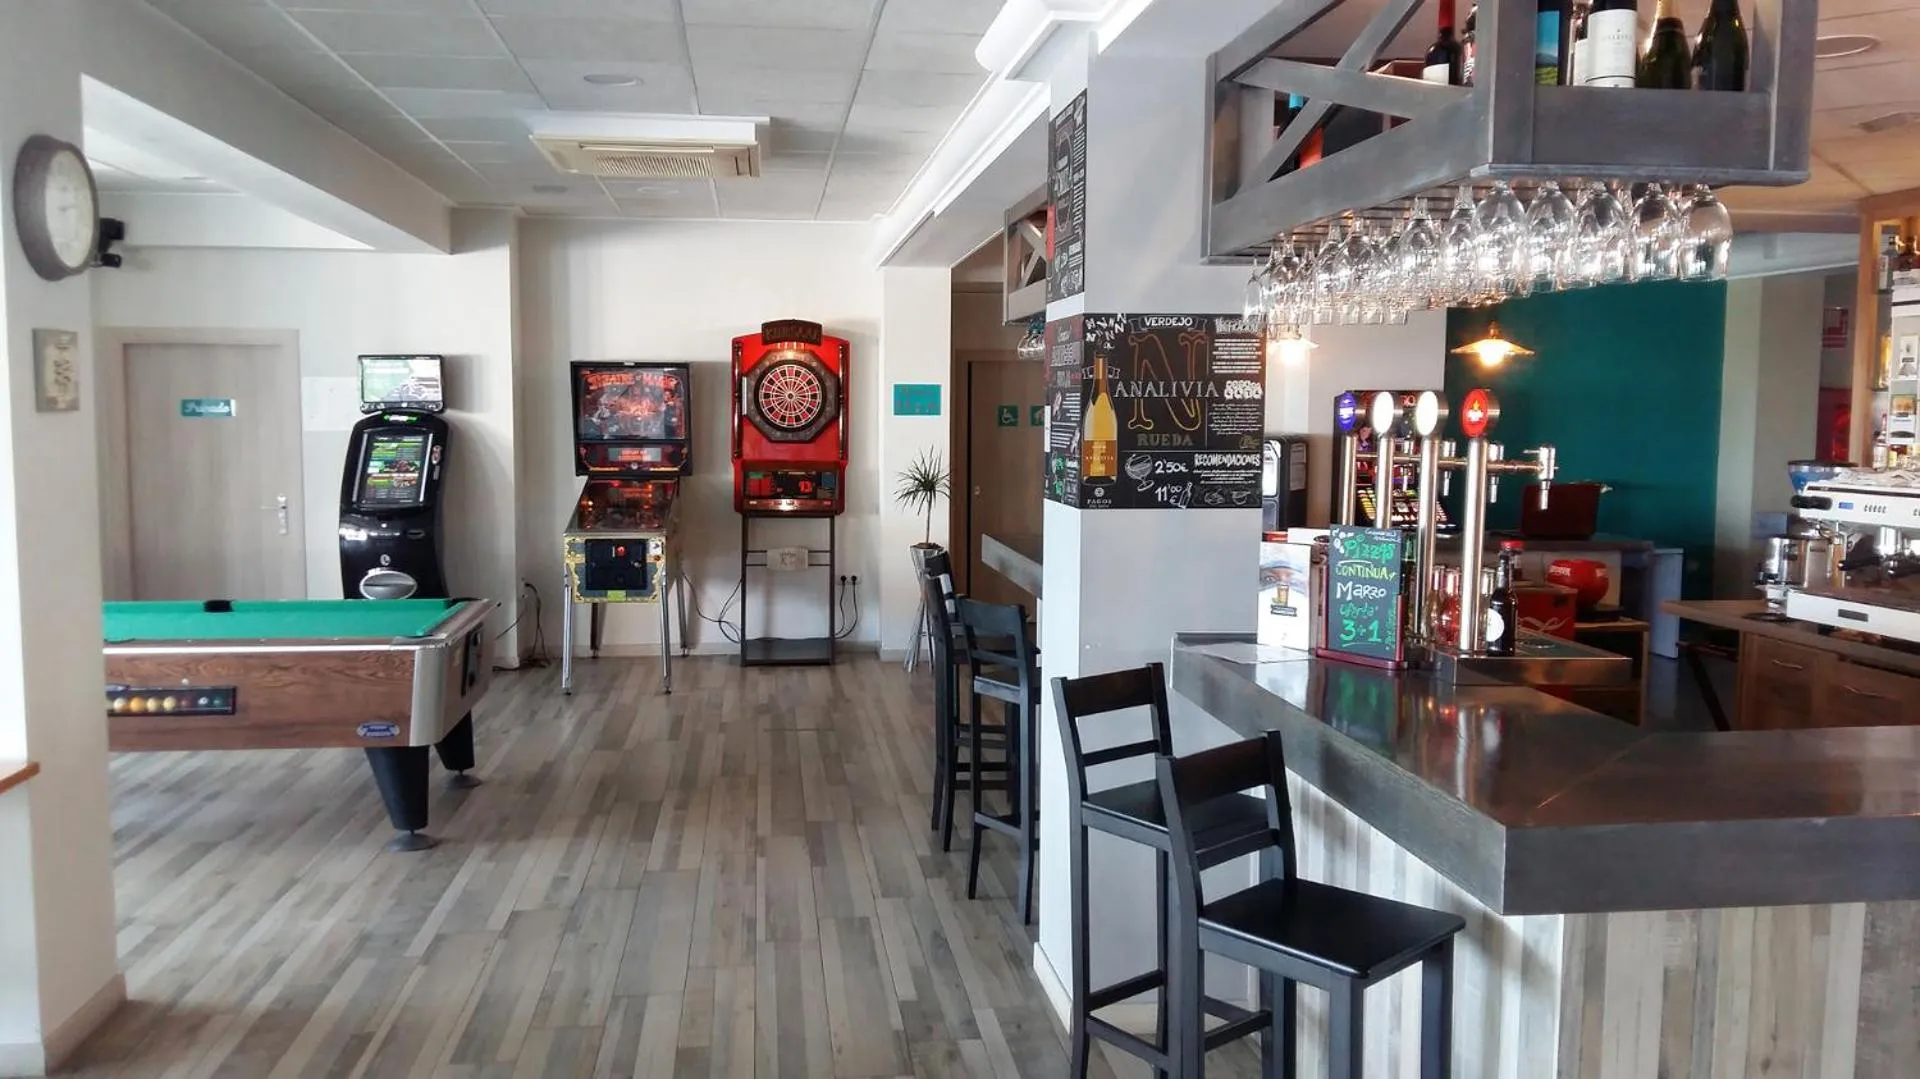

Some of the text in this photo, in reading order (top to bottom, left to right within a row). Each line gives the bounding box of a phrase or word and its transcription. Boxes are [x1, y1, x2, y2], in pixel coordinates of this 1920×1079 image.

[1144, 316, 1193, 326] VERDEJO
[1113, 380, 1220, 398] ANALIVIA
[1136, 433, 1194, 447] RUEDA
